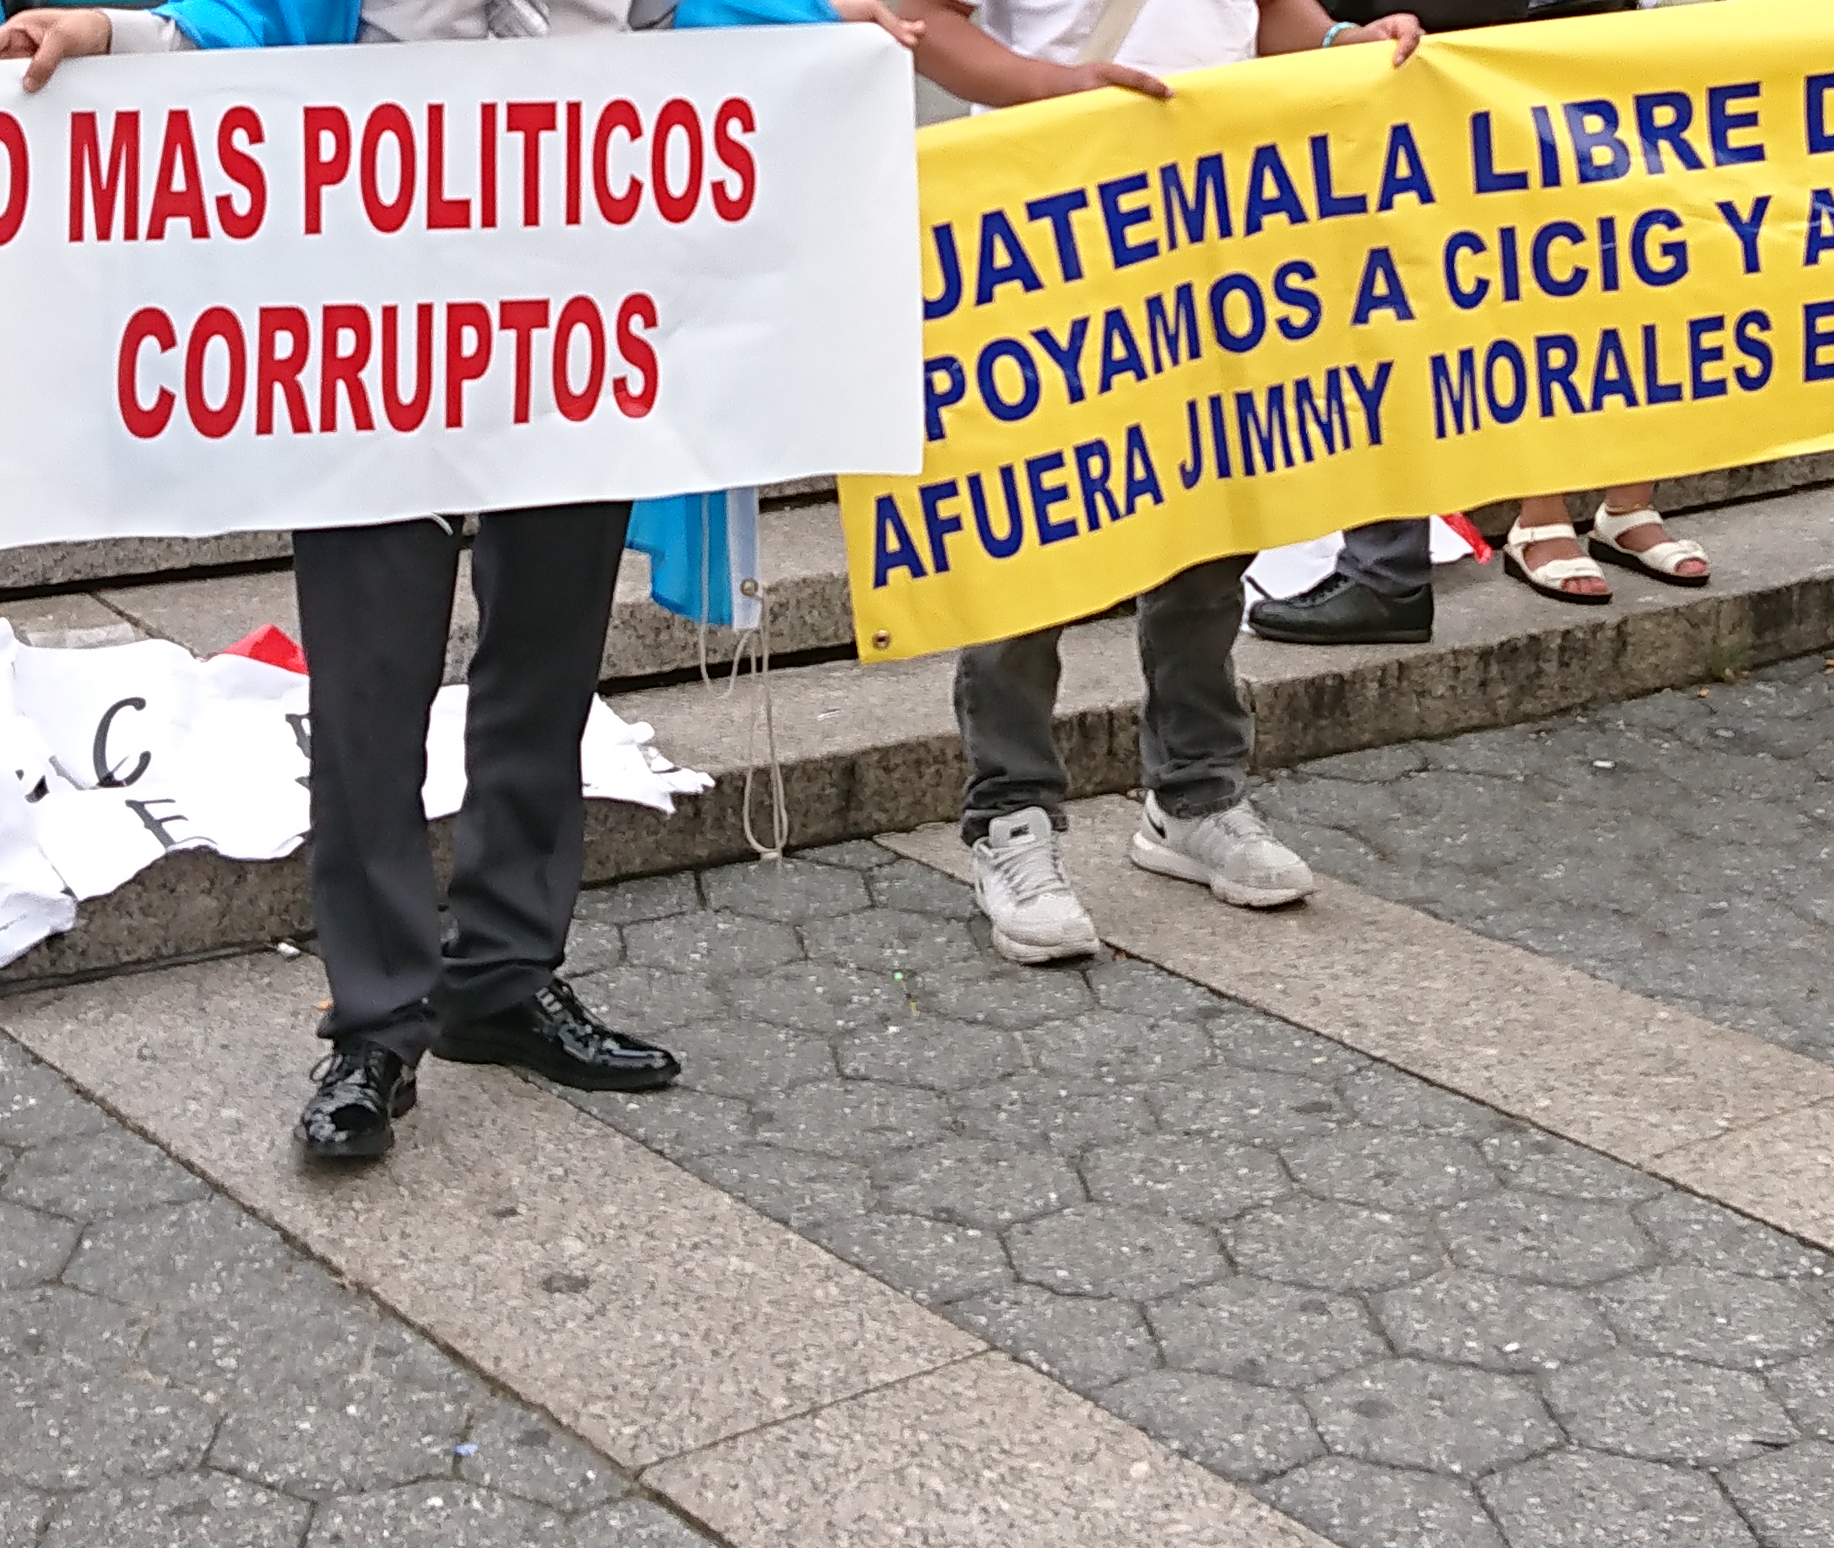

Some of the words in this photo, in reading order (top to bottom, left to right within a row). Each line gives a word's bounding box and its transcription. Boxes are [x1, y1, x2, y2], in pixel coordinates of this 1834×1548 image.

[68, 104, 267, 243] MAS
[304, 96, 758, 236] POLITICOS
[1470, 80, 1767, 197] LIBRE
[1352, 247, 1415, 327] A
[1442, 208, 1689, 312] CICIG
[1719, 196, 1771, 276] Y
[117, 292, 660, 439] CORRUPTOS
[872, 423, 1164, 590] AFUERA
[1179, 360, 1395, 491] JIMMY
[1430, 309, 1776, 441] MORALES
